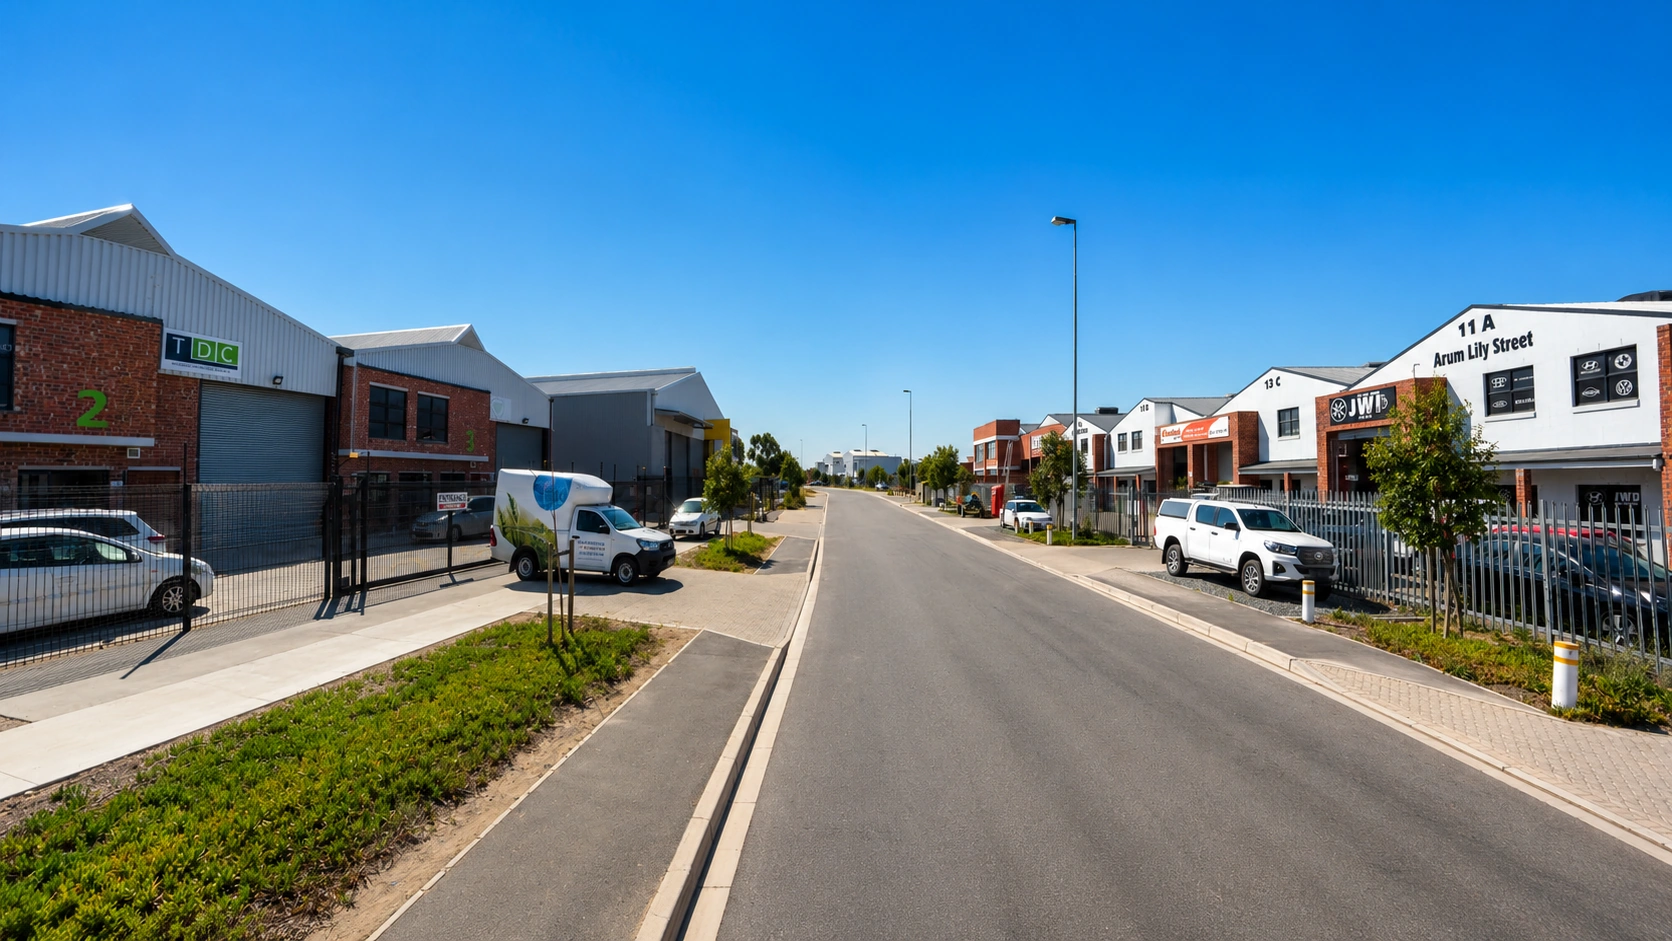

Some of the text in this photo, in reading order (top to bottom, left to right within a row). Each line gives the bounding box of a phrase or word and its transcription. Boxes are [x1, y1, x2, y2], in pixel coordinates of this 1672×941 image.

[1458, 314, 1495, 337] 11 A
[1433, 331, 1533, 368] Arum Lily Street
[1264, 376, 1281, 390] 13 C
[76, 389, 109, 428] 2
[465, 429, 474, 452] 3
